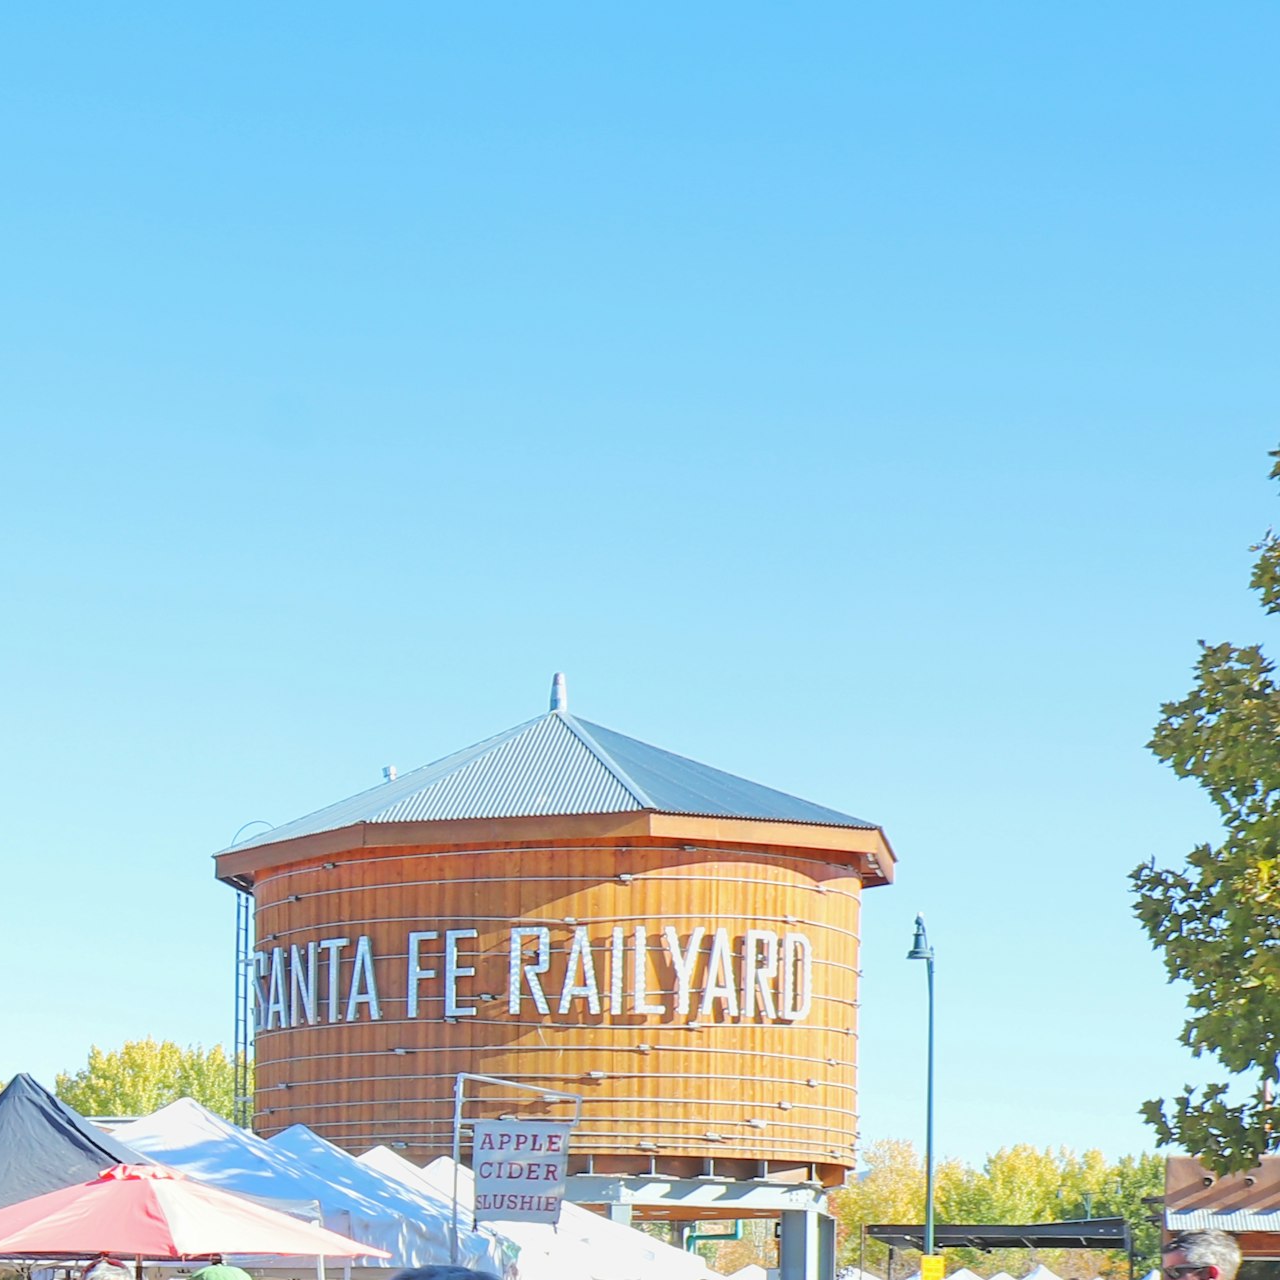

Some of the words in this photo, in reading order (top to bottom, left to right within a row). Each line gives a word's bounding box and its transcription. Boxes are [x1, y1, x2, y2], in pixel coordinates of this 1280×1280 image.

[251, 933, 382, 1034] SANTA
[407, 928, 479, 1019] FE
[508, 925, 815, 1022] RAILYARD
[479, 1133, 562, 1152] APPLE
[479, 1161, 558, 1181] CIDER
[476, 1193, 558, 1212] SLUSHIE
